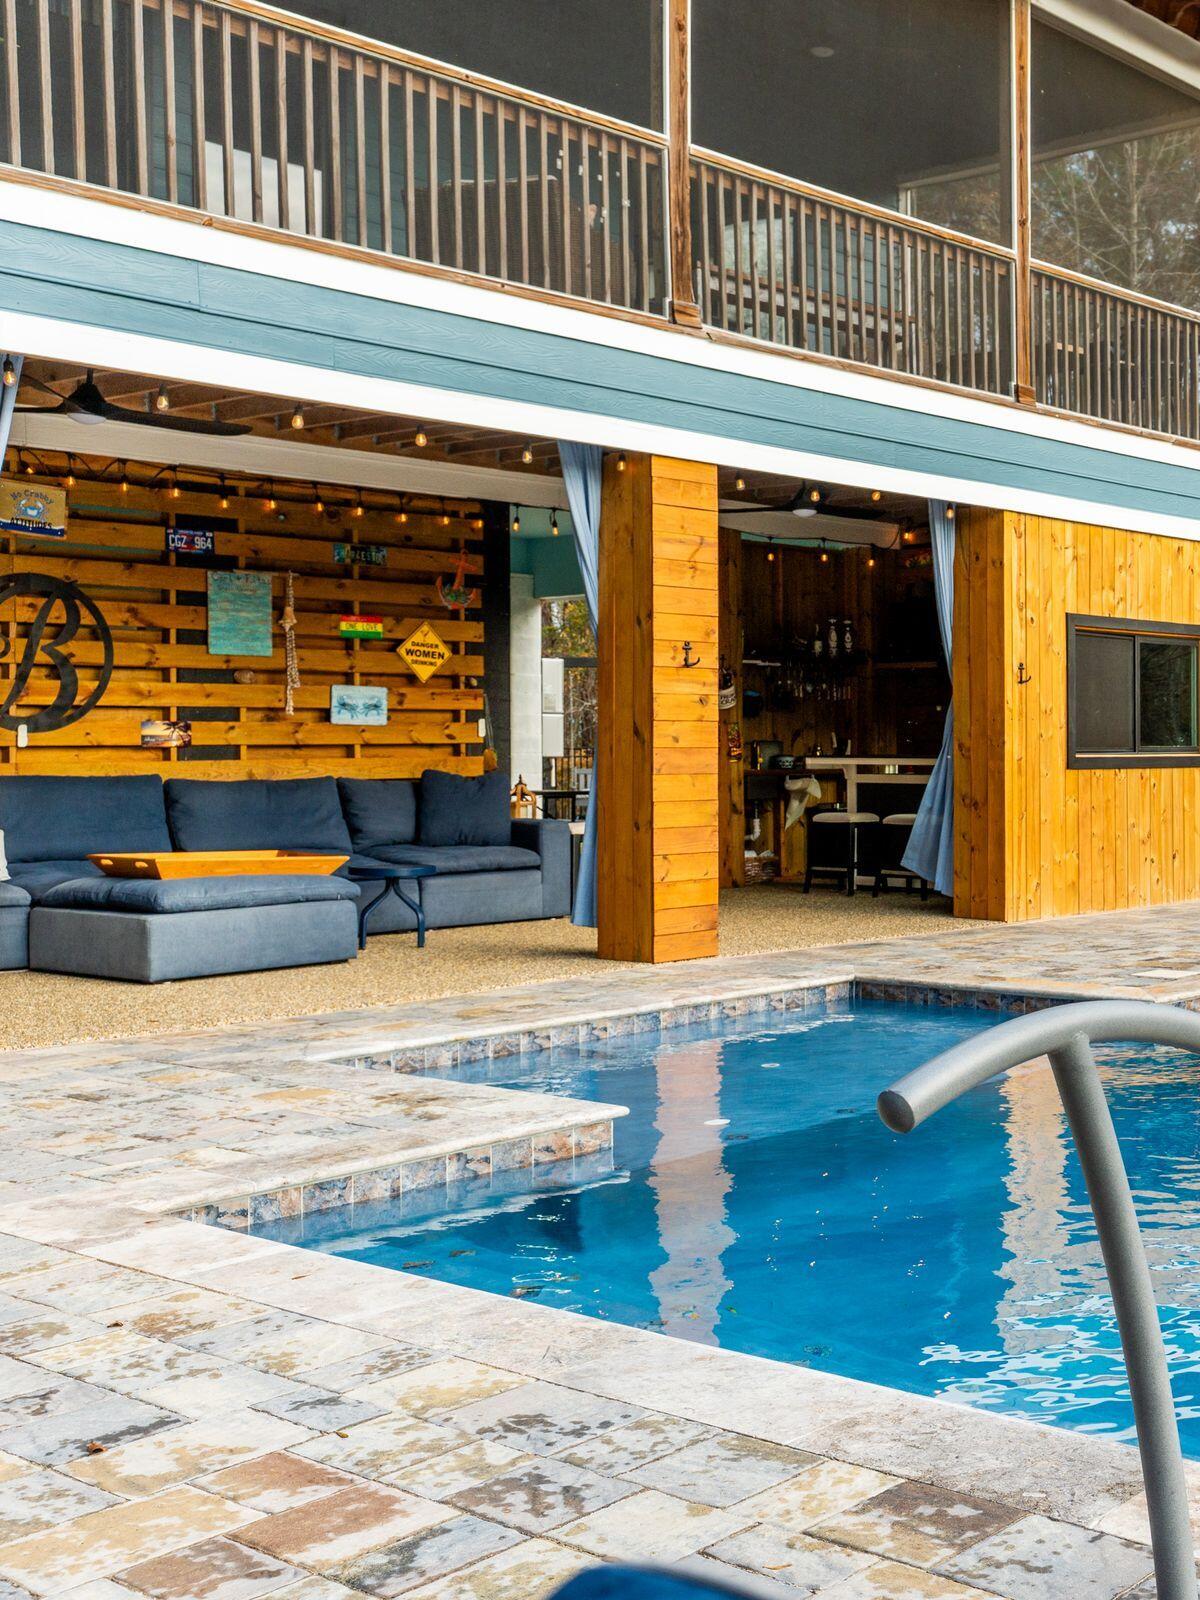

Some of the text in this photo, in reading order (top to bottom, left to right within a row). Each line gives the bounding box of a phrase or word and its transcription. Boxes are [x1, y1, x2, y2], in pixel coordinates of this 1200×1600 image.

[10, 517, 53, 529] ATTITUDES
[168, 534, 213, 550] CGZ 964
[345, 622, 379, 632] ONE LOVE
[411, 641, 439, 649] DANGER
[405, 648, 445, 660] WOMEN
